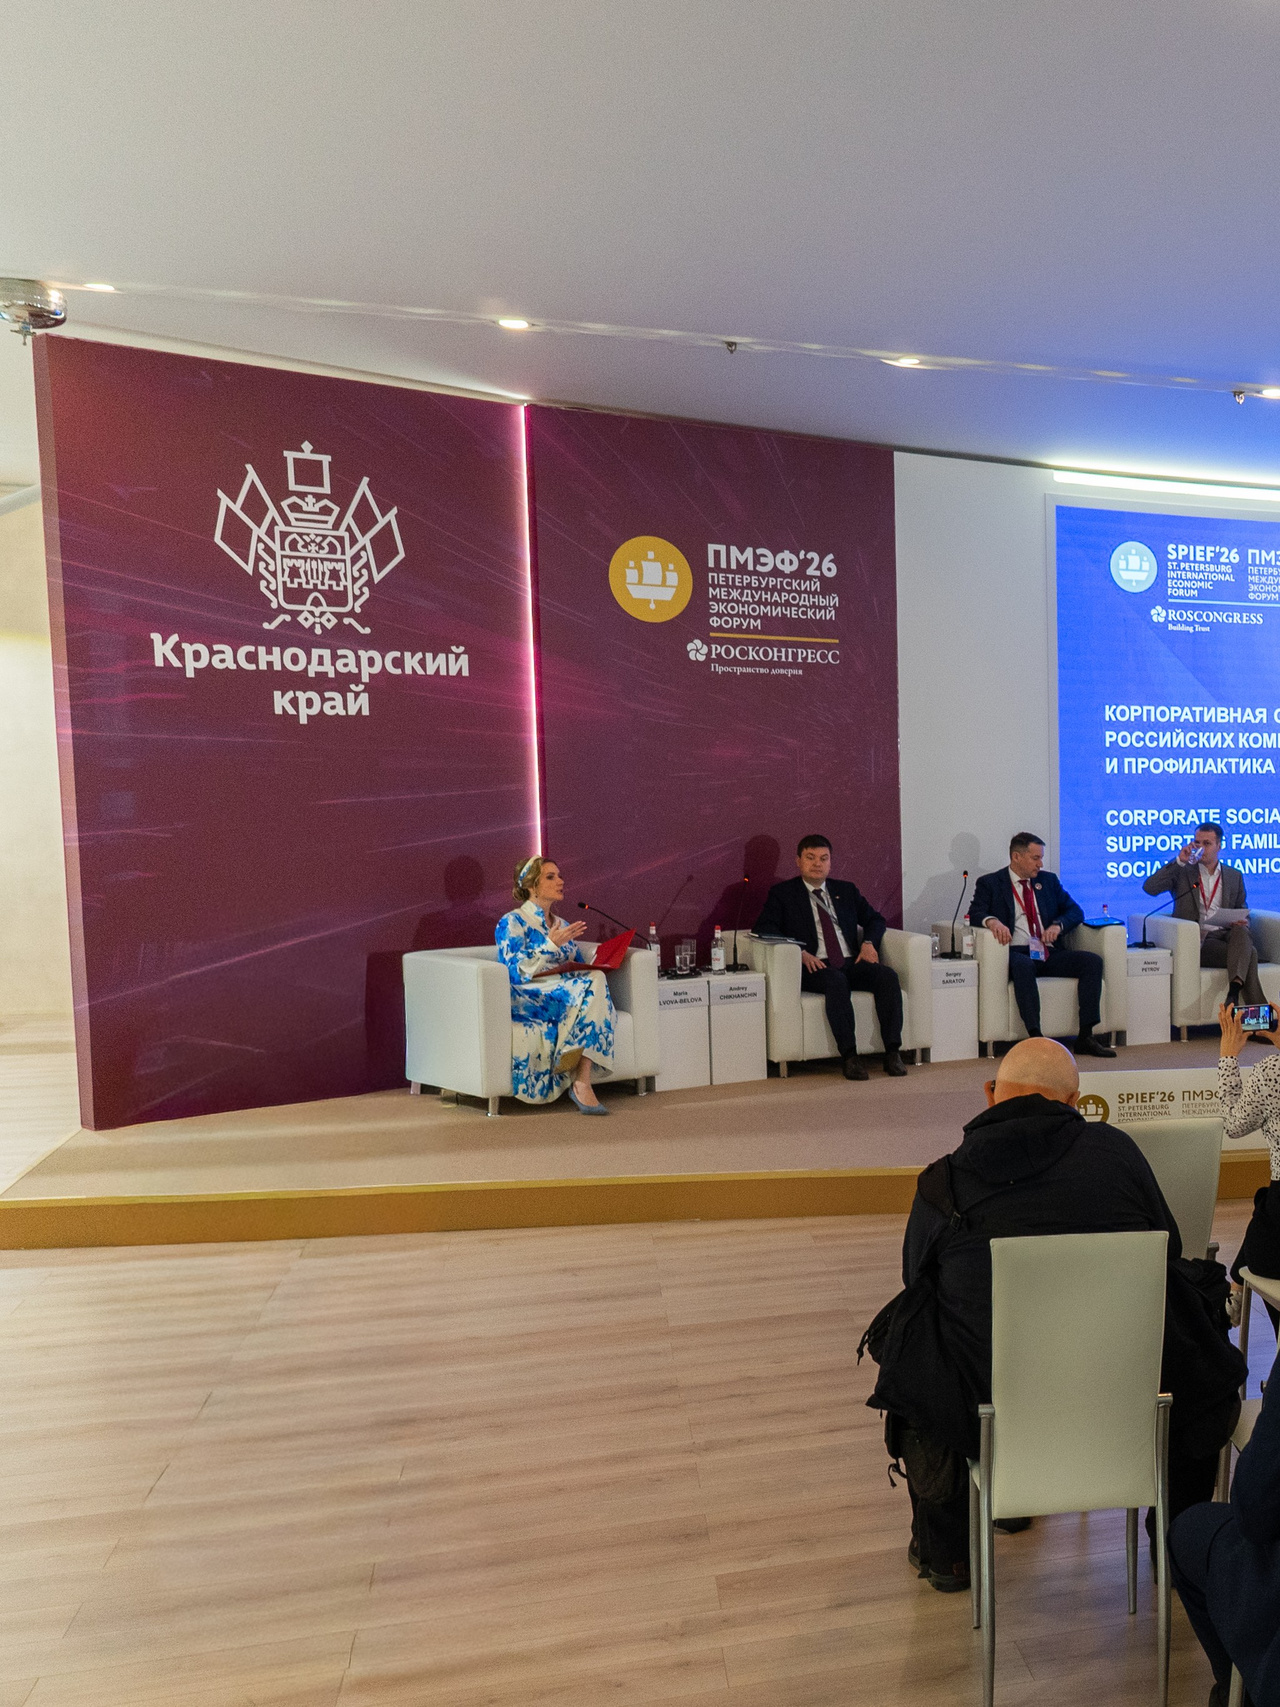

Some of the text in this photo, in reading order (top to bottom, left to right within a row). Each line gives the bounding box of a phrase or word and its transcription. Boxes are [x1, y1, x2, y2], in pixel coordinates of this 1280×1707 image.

[1167, 561, 1232, 573] ST. PETERSBURG
[708, 572, 821, 592] ПЕТЕРБУРГСКИЙ
[1167, 570, 1236, 582] INTERNATIONAL
[1167, 579, 1214, 590] ECONOMIC
[708, 587, 839, 607] МЕЖДУНАРОДНЫЙ
[1167, 587, 1198, 597] FORUM
[1248, 592, 1279, 601] ФОРУМ
[709, 601, 836, 621] ЭКОНОМИЧЕСКИЙ
[1168, 609, 1264, 625] ROSCONGRESS
[709, 615, 762, 630] ФОРУМ
[1168, 623, 1210, 633] Building Trust
[150, 632, 470, 678] Краснодарский
[710, 643, 840, 664] РОСКОНГРЕСС
[711, 663, 803, 677] Пространство доверия
[272, 684, 370, 724] край
[1104, 705, 1267, 723] КОРПОРАТИВНАЯ
[1105, 728, 1235, 748] РОССИЙСКИХ
[1105, 757, 1118, 774] И
[1124, 757, 1275, 774] ПРОФИЛАКТИКА
[1105, 808, 1220, 826] CORPORATE
[1106, 834, 1227, 852] SUPPORT
[1106, 860, 1169, 878] SOCIA
[1182, 1101, 1220, 1109] ПЕТЕРБУРГ
[1117, 1110, 1172, 1118] INTERNATIONAL
